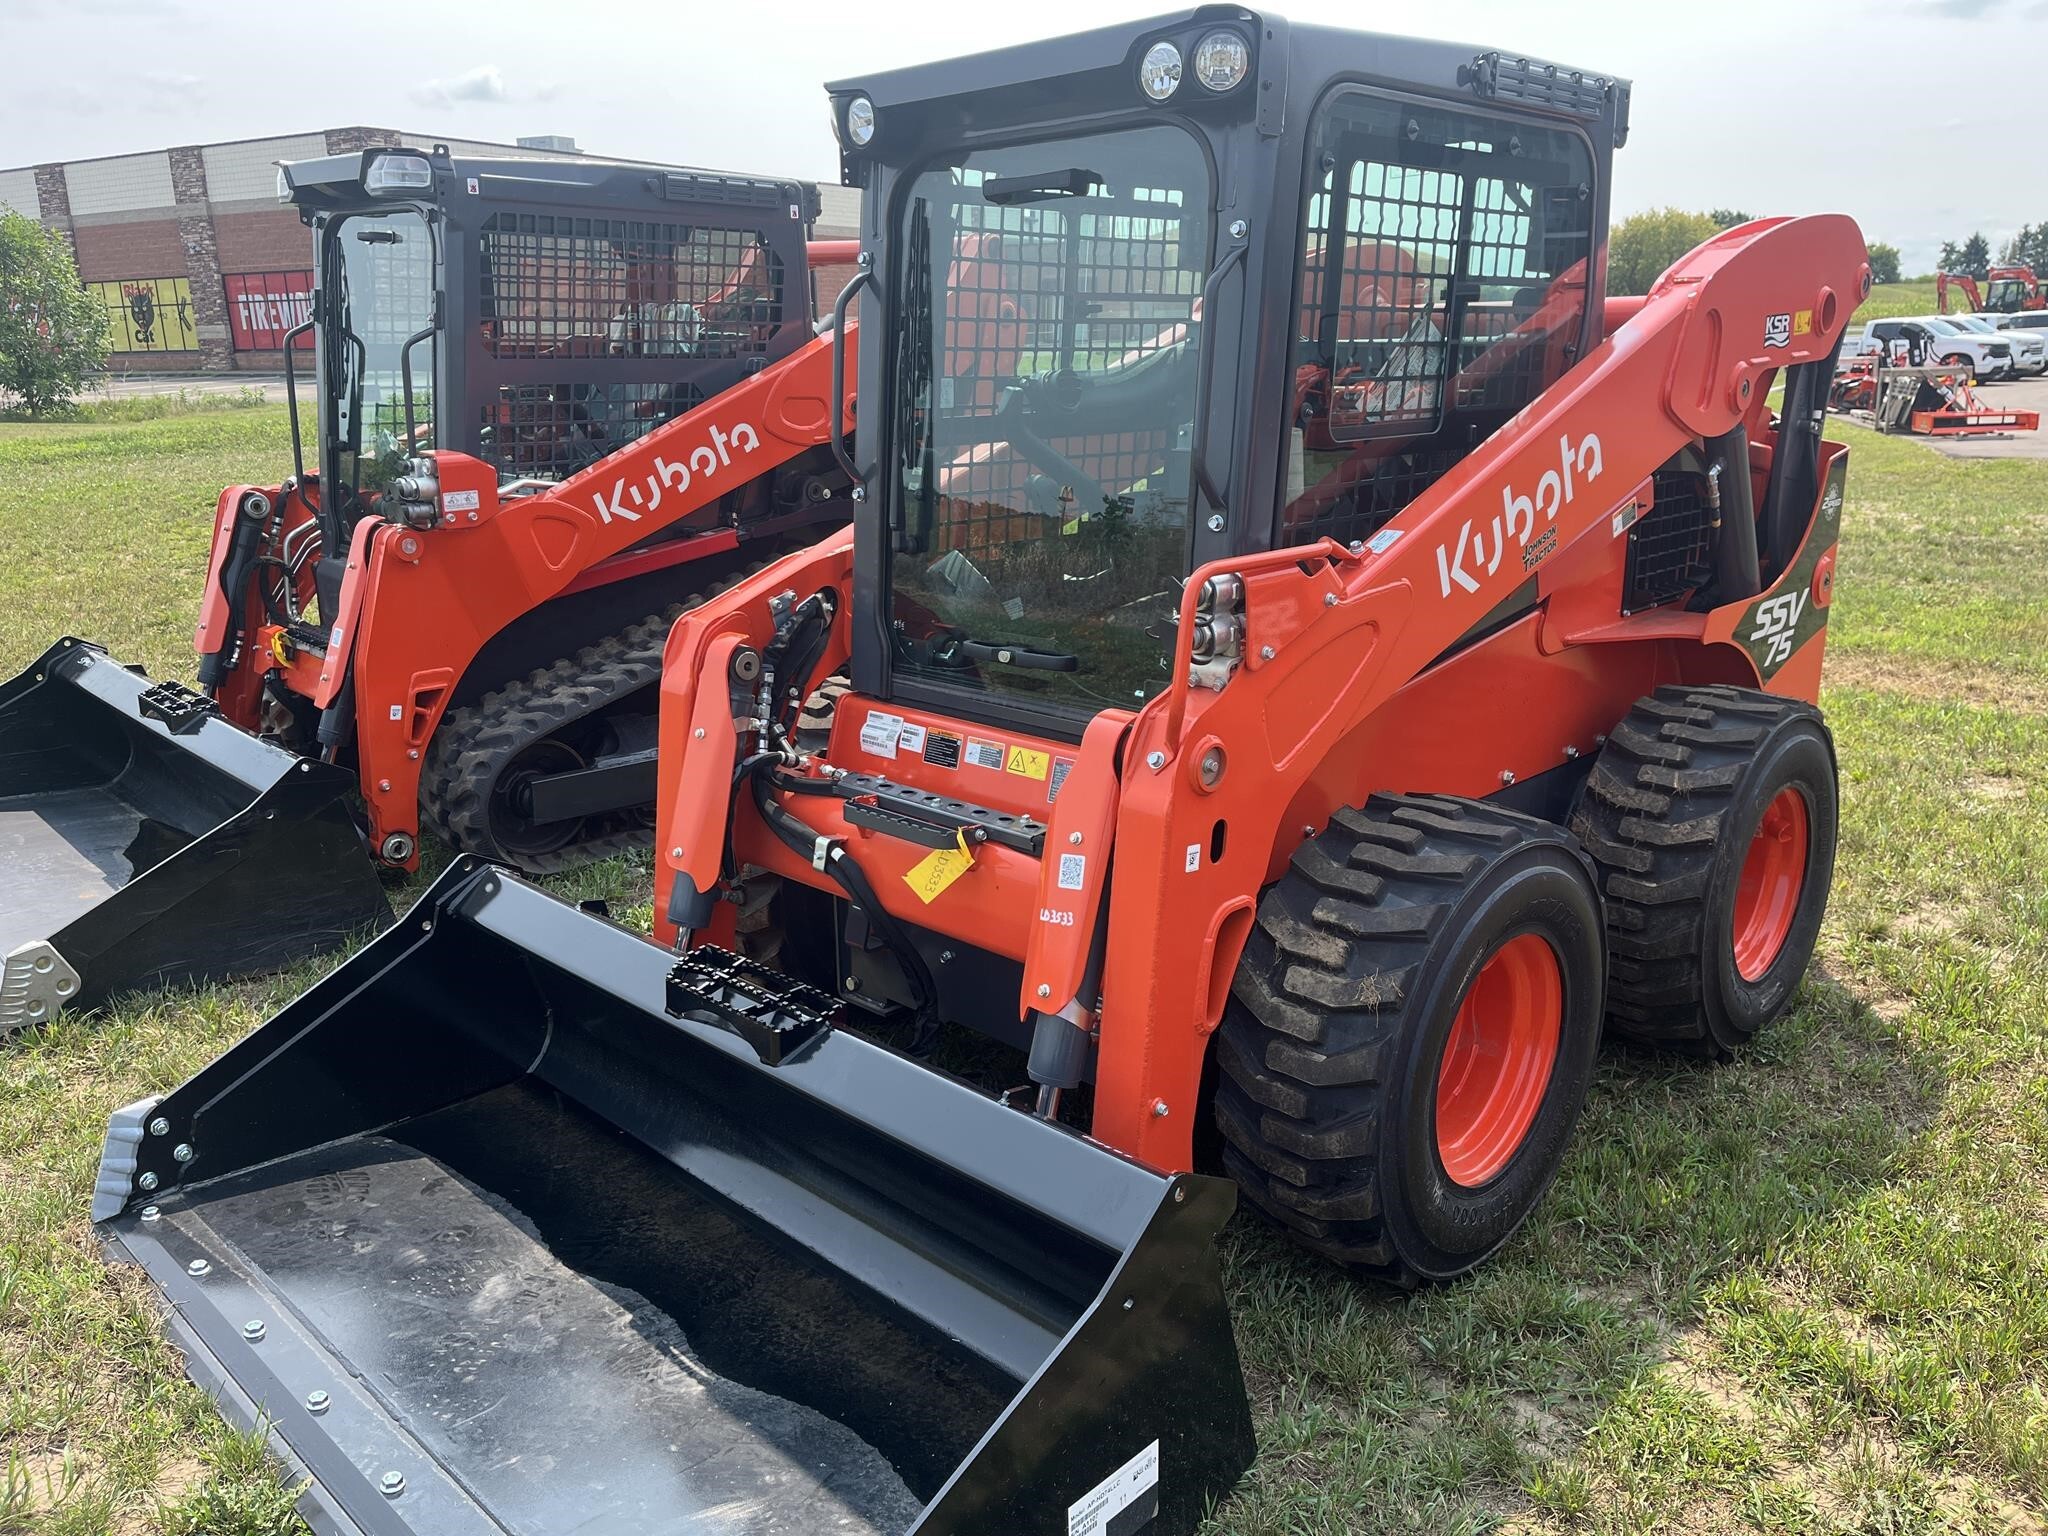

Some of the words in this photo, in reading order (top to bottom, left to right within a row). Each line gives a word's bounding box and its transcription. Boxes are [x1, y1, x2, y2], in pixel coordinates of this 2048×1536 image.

[122, 282, 154, 299] Black
[134, 328, 155, 343] Cat
[1765, 314, 1790, 335] KSR
[592, 422, 760, 525] Kubota
[1436, 432, 1603, 599] Kubota
[1750, 587, 1810, 642] SSV
[1763, 628, 1795, 667] 75
[1039, 908, 1074, 926] LD3533
